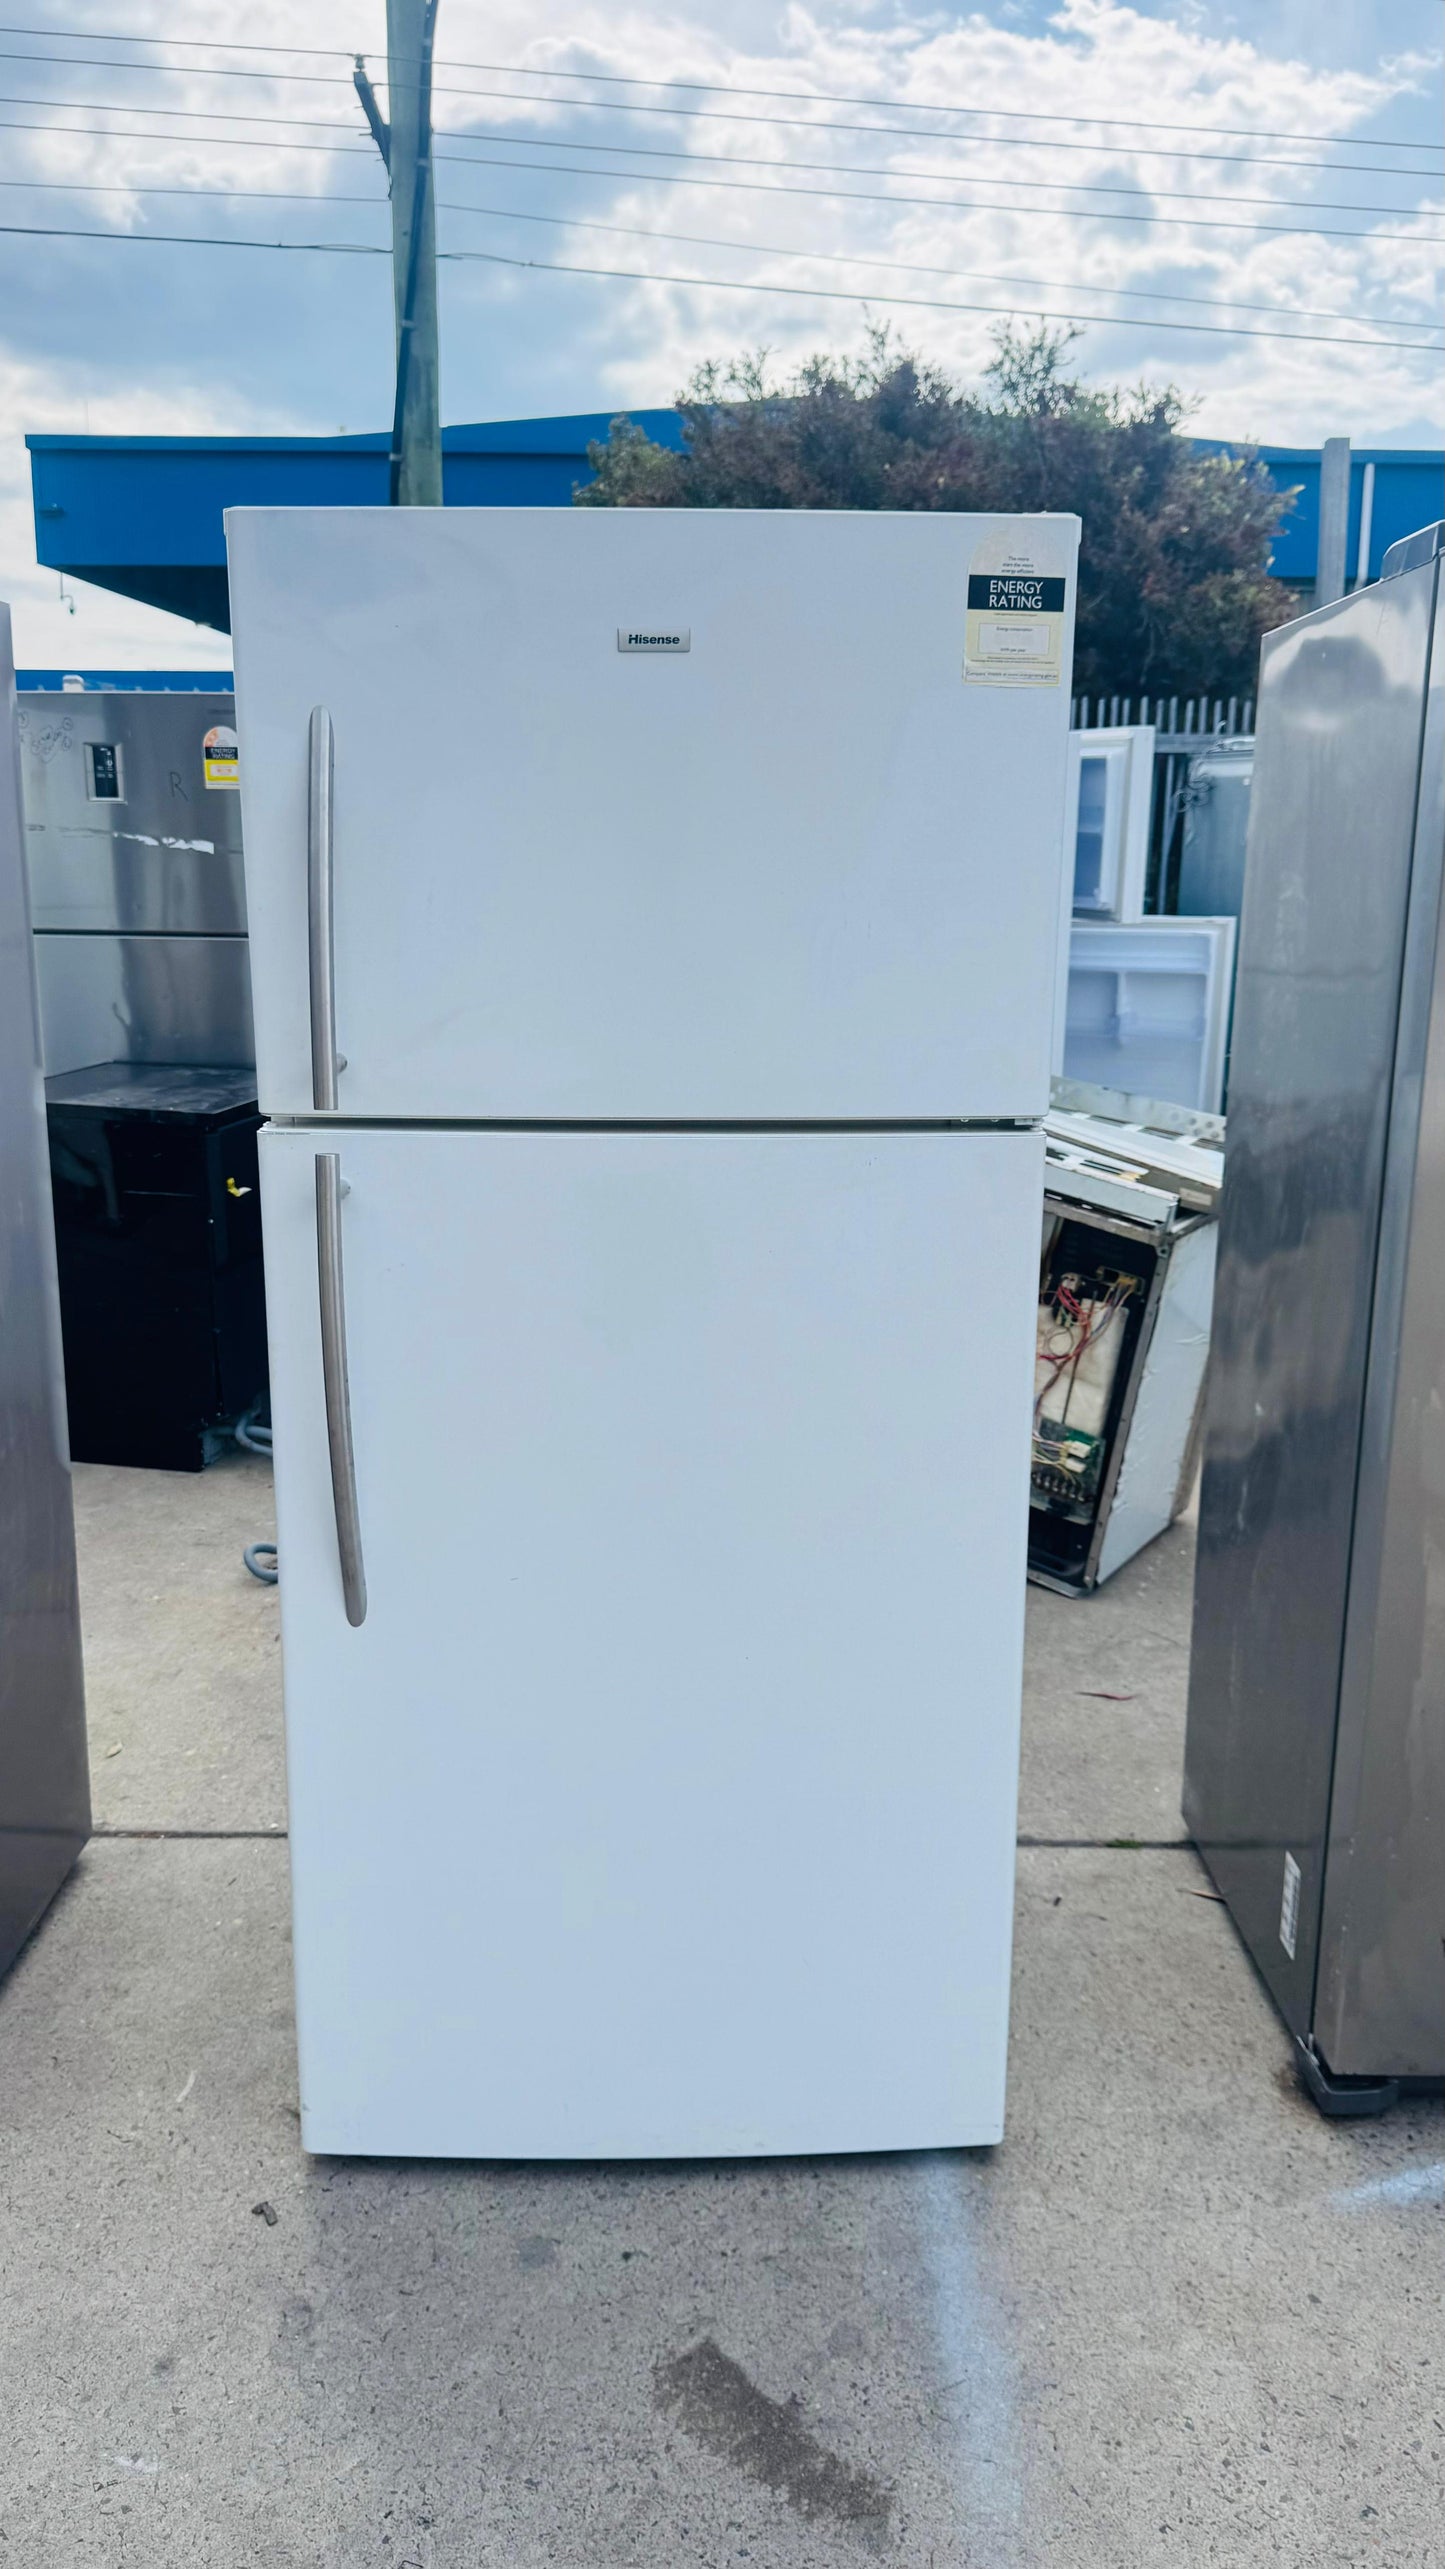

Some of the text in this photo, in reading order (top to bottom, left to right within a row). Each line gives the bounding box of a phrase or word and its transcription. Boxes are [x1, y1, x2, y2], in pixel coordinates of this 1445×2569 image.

[990, 580, 1043, 594] ENERGY
[989, 595, 1043, 609] RATING
[628, 634, 681, 645] Hisense
